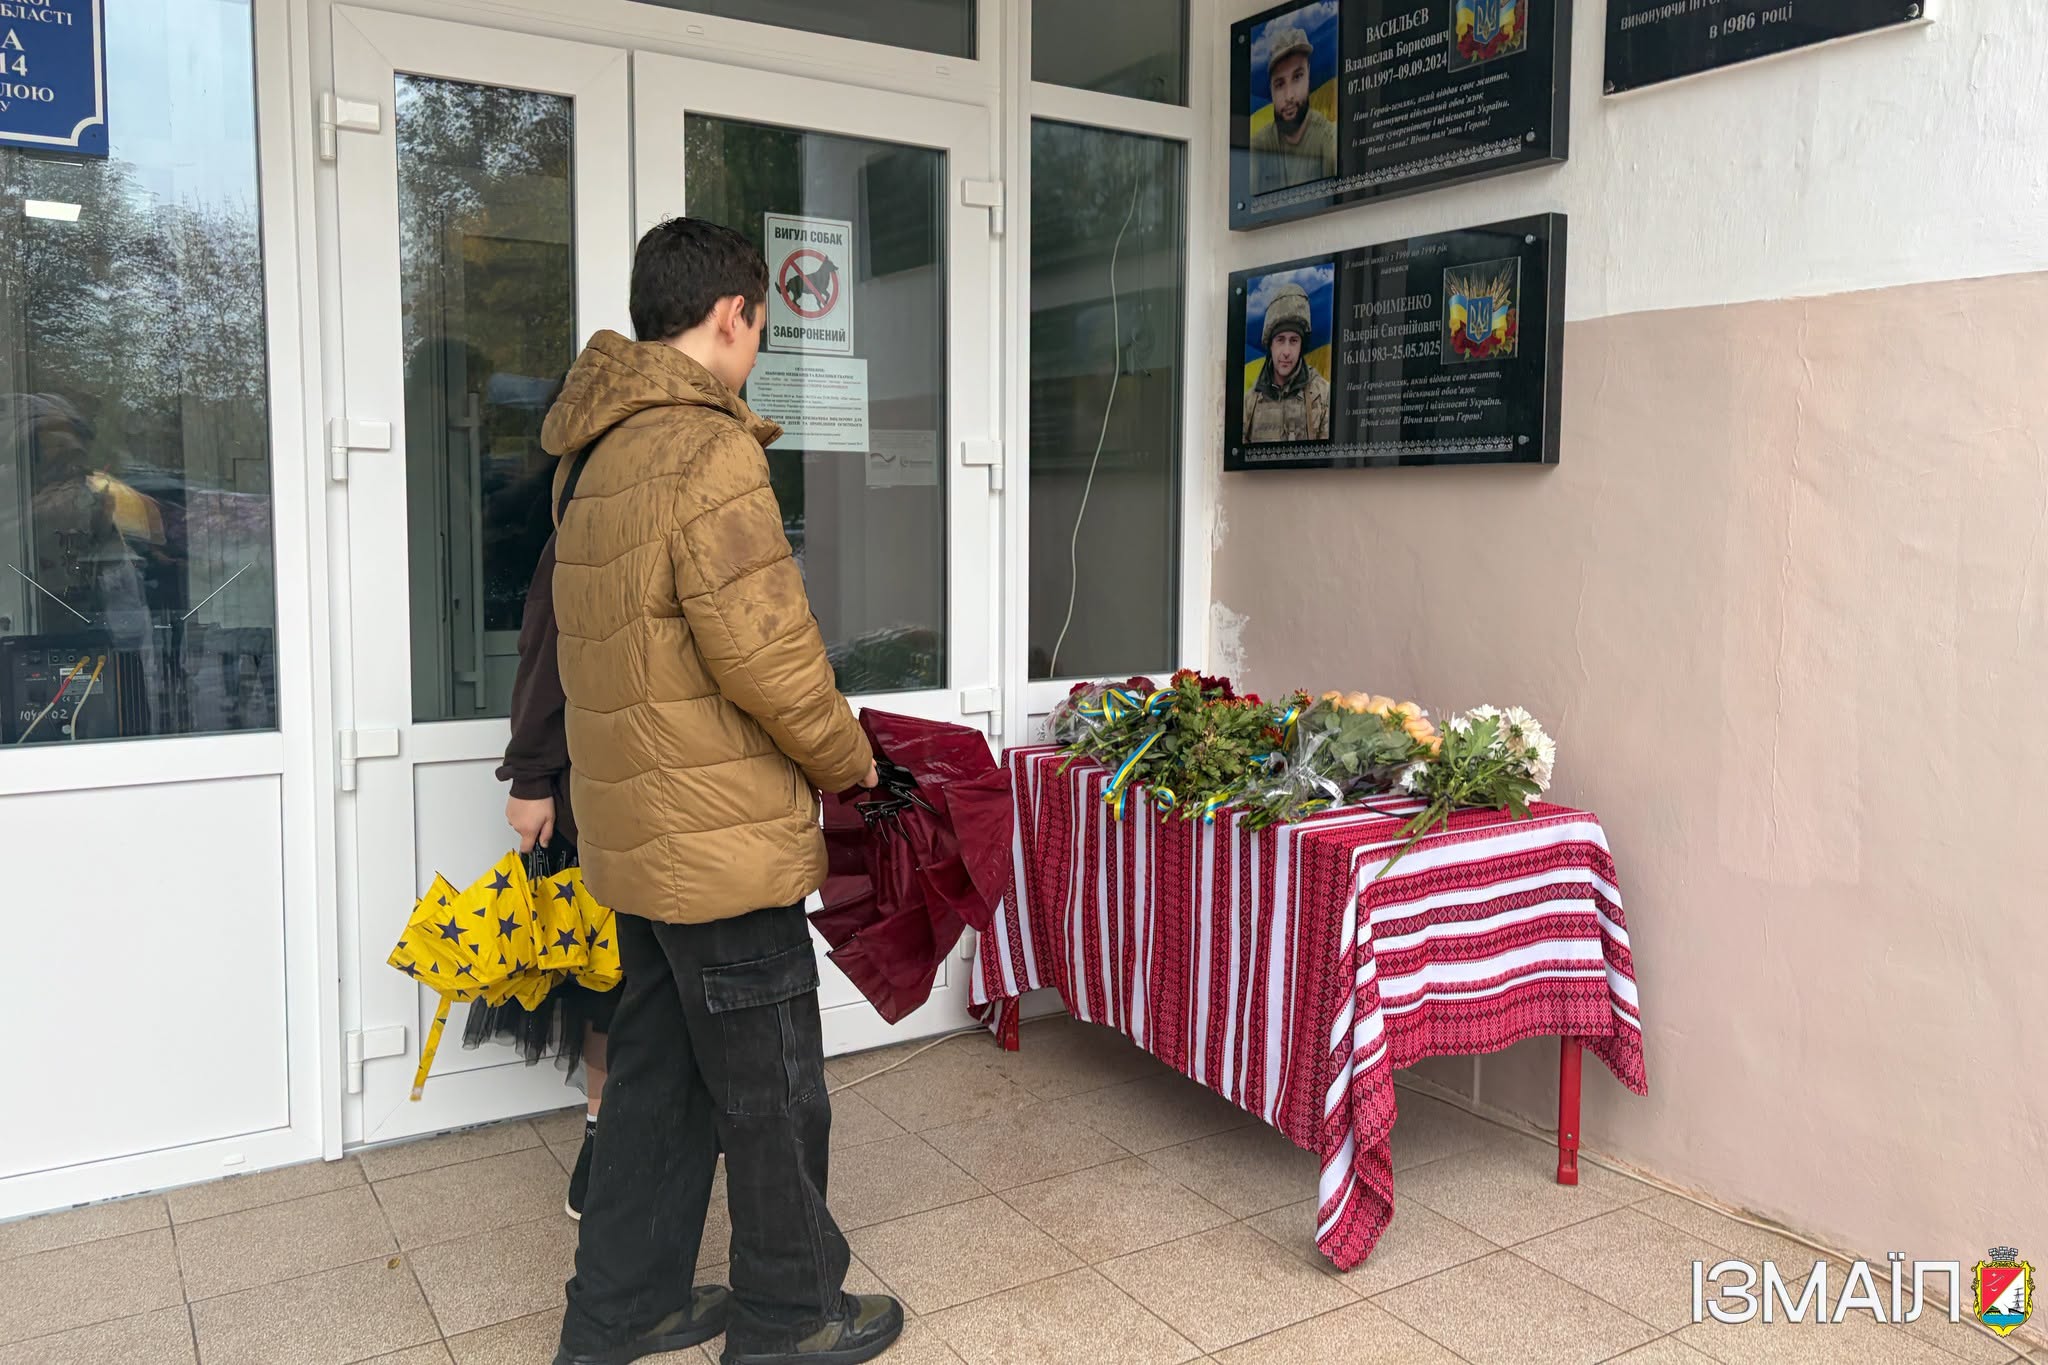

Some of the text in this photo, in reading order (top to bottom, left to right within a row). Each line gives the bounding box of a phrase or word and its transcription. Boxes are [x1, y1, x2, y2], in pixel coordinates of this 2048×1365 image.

[1366, 8, 1429, 43] ВАСИЛЬЄВ
[1723, 12, 1755, 36] 1986
[1345, 30, 1448, 73] Владислав Борисович
[775, 227, 842, 245] ВИГУЛ СОБАК
[1353, 293, 1431, 319] ТРОФИМЕНКО
[773, 326, 846, 342] ЗАБОРОНЕНИЙ
[1343, 320, 1441, 344] Валерій Євгенійович
